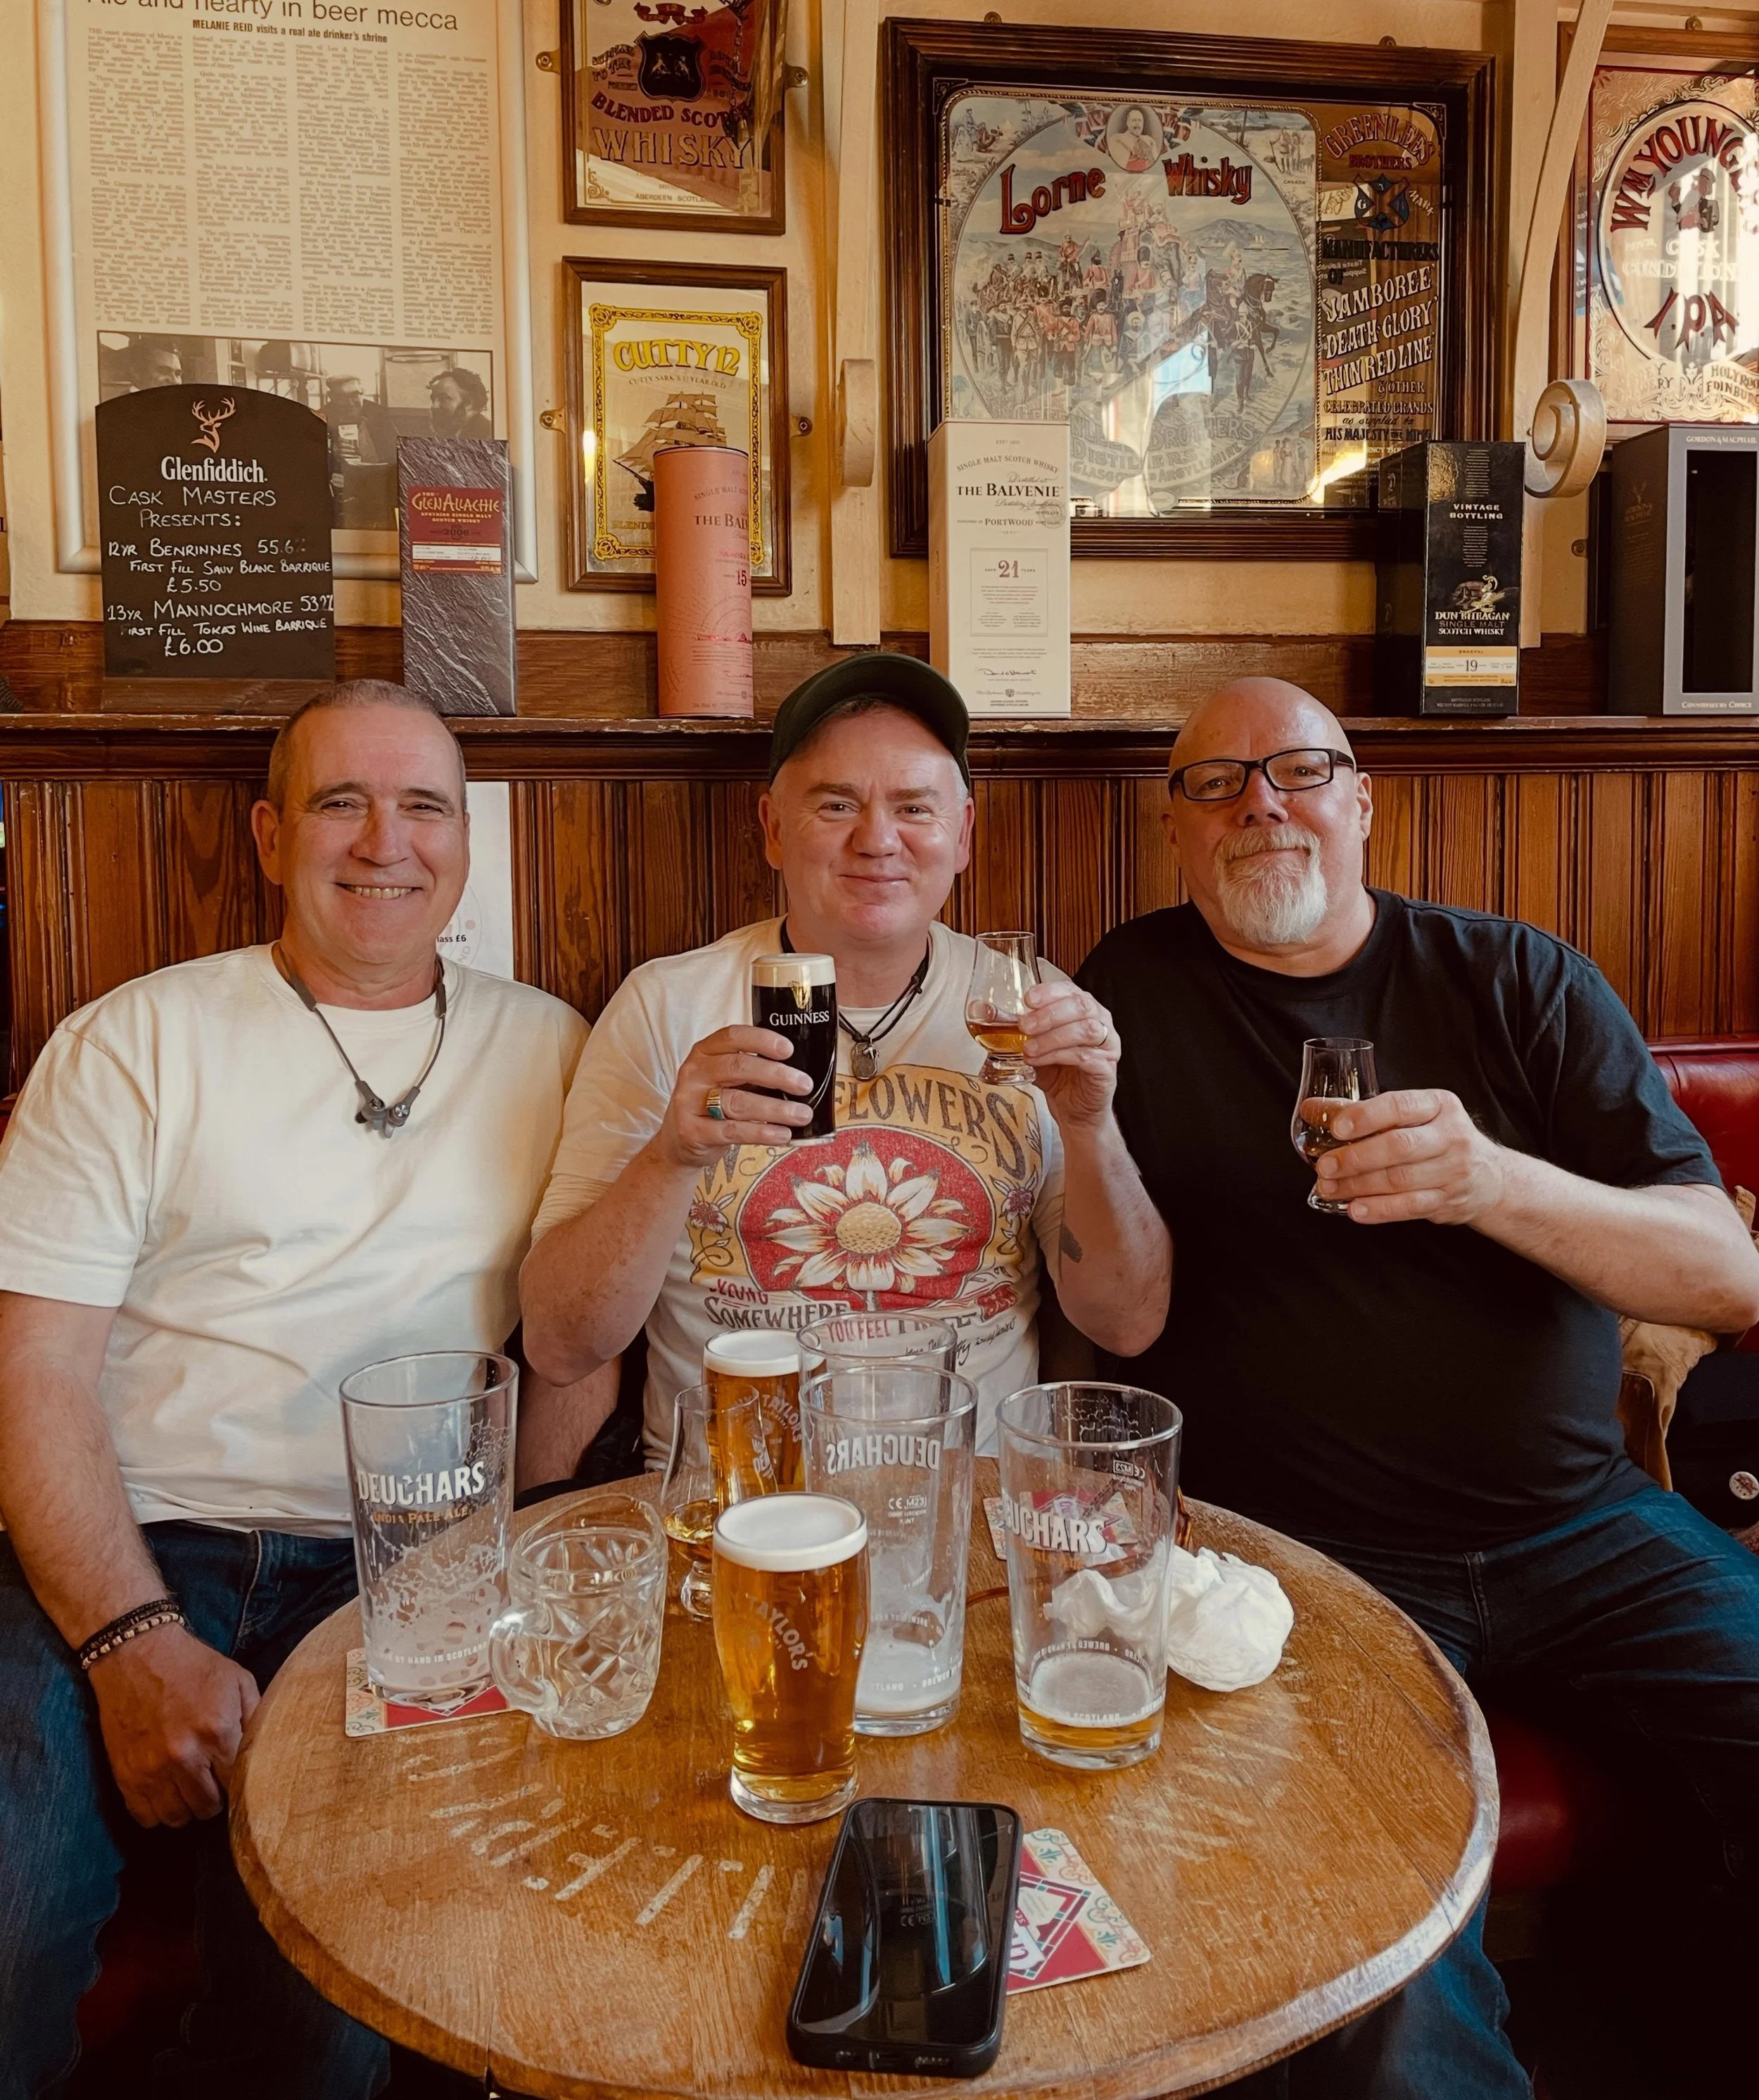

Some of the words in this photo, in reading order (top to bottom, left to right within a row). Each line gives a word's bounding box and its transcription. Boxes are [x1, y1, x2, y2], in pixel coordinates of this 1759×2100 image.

[283, 0, 301, 18] in
[312, 0, 368, 23] beer
[377, 8, 458, 30] mecca
[193, 19, 229, 30] MELANIE
[233, 22, 253, 32] REID
[256, 24, 277, 34] visits
[289, 27, 305, 36] real
[308, 29, 320, 37] ale
[324, 30, 359, 41] drinker's
[362, 32, 387, 42] shrine
[592, 91, 674, 122] BLENDED
[592, 127, 752, 170] WHISKY
[1324, 113, 1436, 165] GREENLEES
[635, 193, 672, 201] ABERDEEN
[1000, 163, 1107, 235] Lorne
[1162, 153, 1253, 204] Whisky
[613, 339, 716, 372] CUTTY
[1364, 349, 1397, 382] RED
[1388, 381, 1425, 394] OTHER
[1323, 400, 1391, 415] CELEBRATED
[1392, 400, 1434, 415] BRANDS
[1325, 428, 1342, 441] HIS
[1071, 436, 1198, 469] DISTILERS
[956, 459, 982, 472] SINGLE
[1005, 455, 1031, 464] SCOTCH
[1034, 460, 1059, 474] WHISKY
[109, 486, 164, 505] CASK
[184, 486, 277, 507] MASTERS
[956, 486, 982, 496] THE
[986, 483, 1060, 498] BALVENIE
[140, 509, 241, 528] PRESENTS:
[694, 514, 721, 526] THE
[150, 538, 243, 557] BENRINNES
[129, 559, 165, 572] FIRST
[171, 560, 194, 574] FILL
[203, 562, 234, 575] SAUV
[240, 560, 276, 574] BLANC
[281, 559, 331, 574] BARRIQUE
[998, 560, 1020, 578] 21
[735, 569, 748, 586] 15
[153, 599, 293, 619] MANNOCHMORE
[1435, 612, 1458, 621] DUN
[158, 624, 186, 636] FILL
[241, 621, 271, 633] WINE
[275, 618, 327, 631] BARRIQUE
[1438, 627, 1472, 635] SCOTCH
[1474, 627, 1505, 635] WHISKY
[1465, 659, 1478, 672] 19
[437, 935, 453, 943] lass
[455, 935, 466, 943] £6
[769, 1010, 830, 1027] GUINNESS
[357, 1460, 485, 1506] DEUCHARS
[447, 1640, 488, 1661] SCOTLAND
